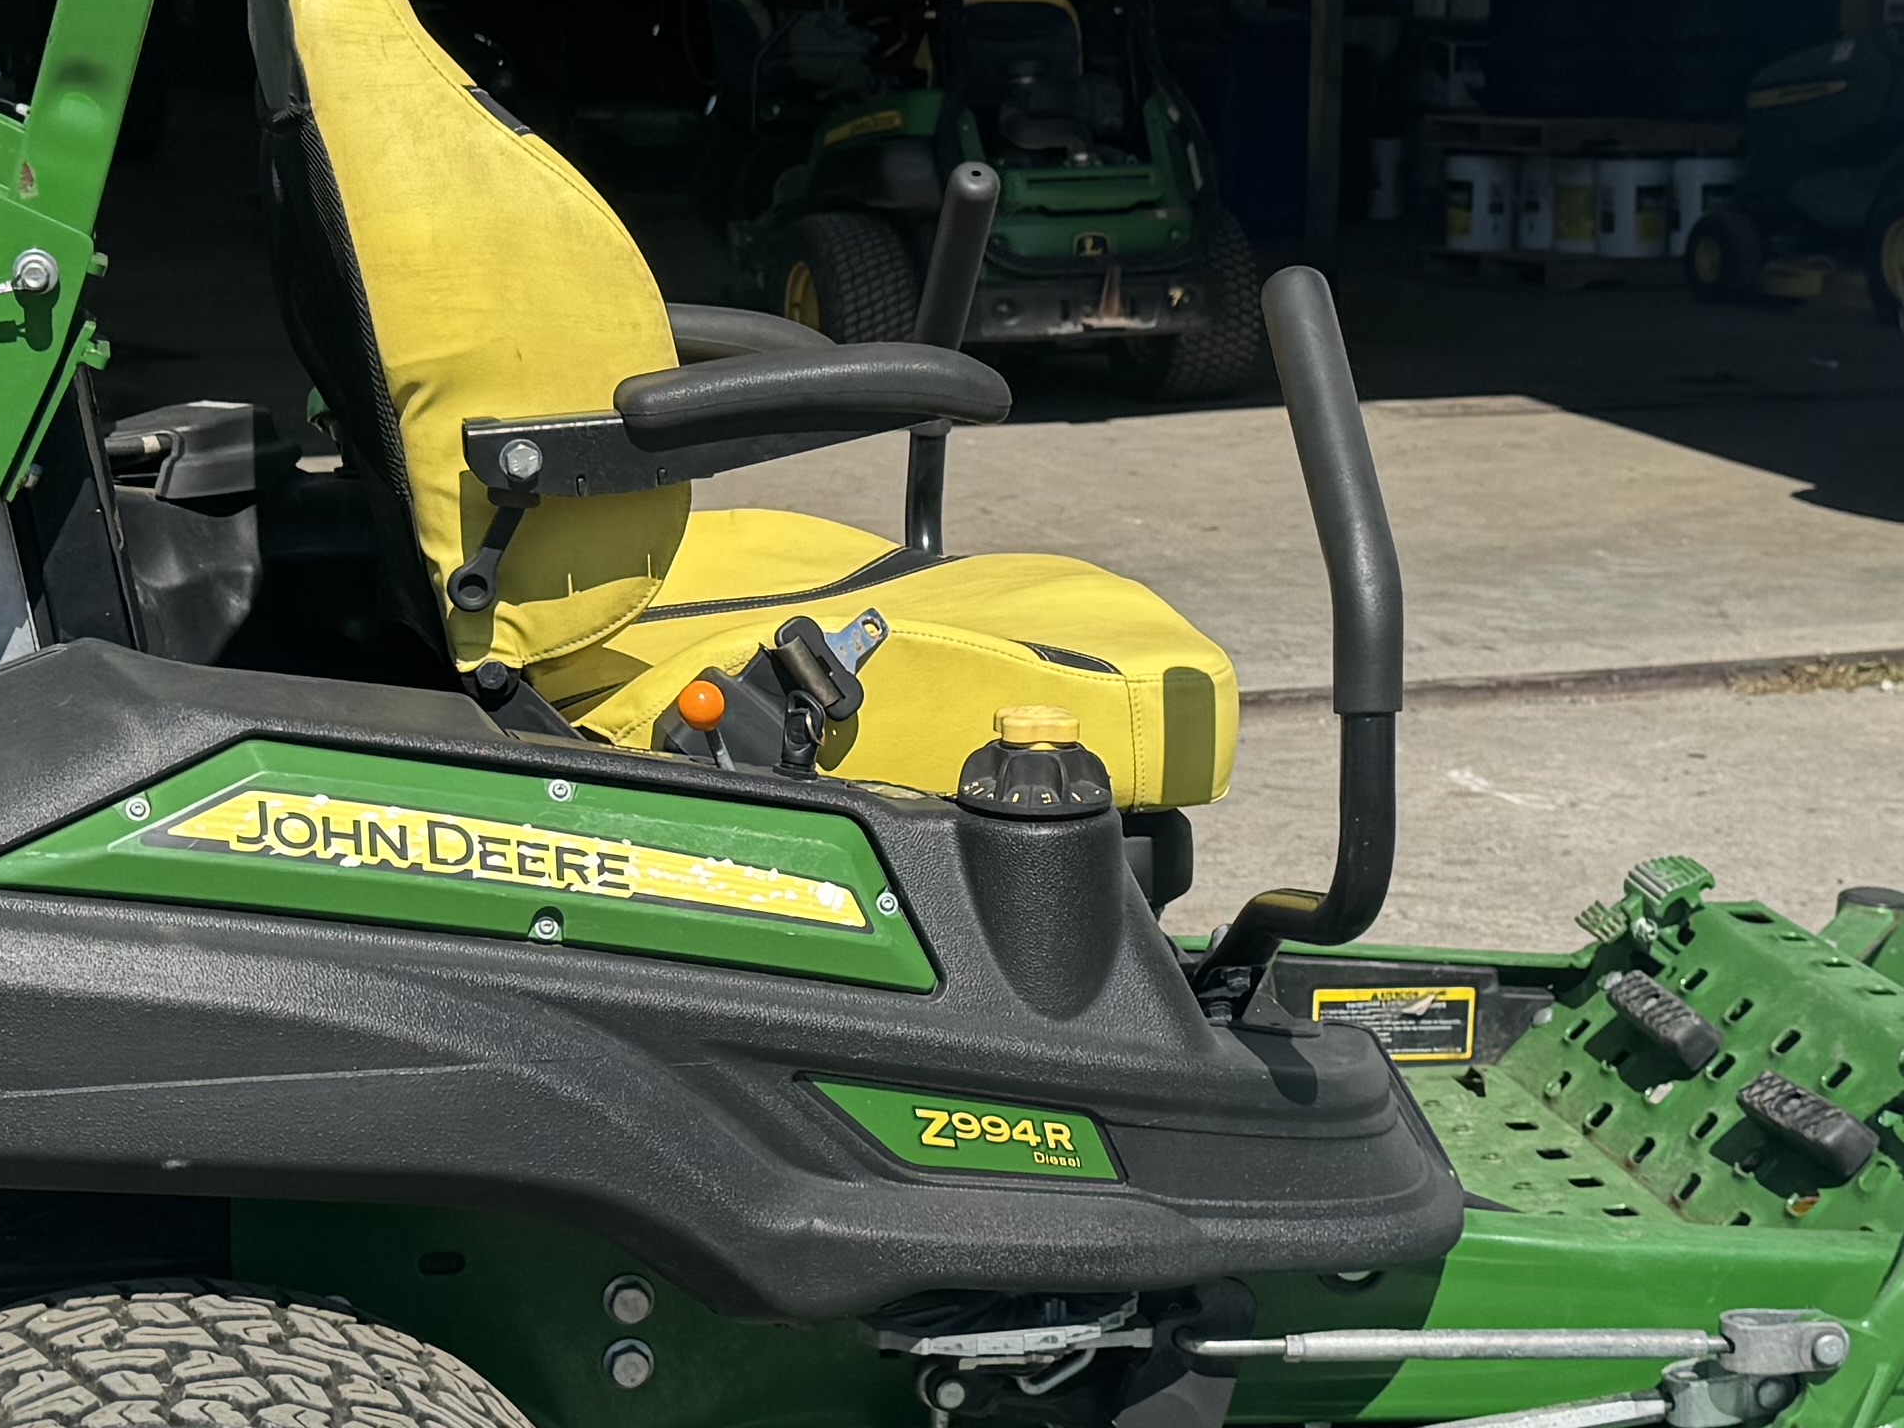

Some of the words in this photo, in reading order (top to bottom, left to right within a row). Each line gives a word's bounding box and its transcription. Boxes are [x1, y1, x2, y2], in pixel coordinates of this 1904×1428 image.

[236, 800, 408, 861] JOHN
[427, 819, 631, 890] DEERE
[913, 1106, 1075, 1152] Z994R
[1033, 1150, 1082, 1169] Diesel
